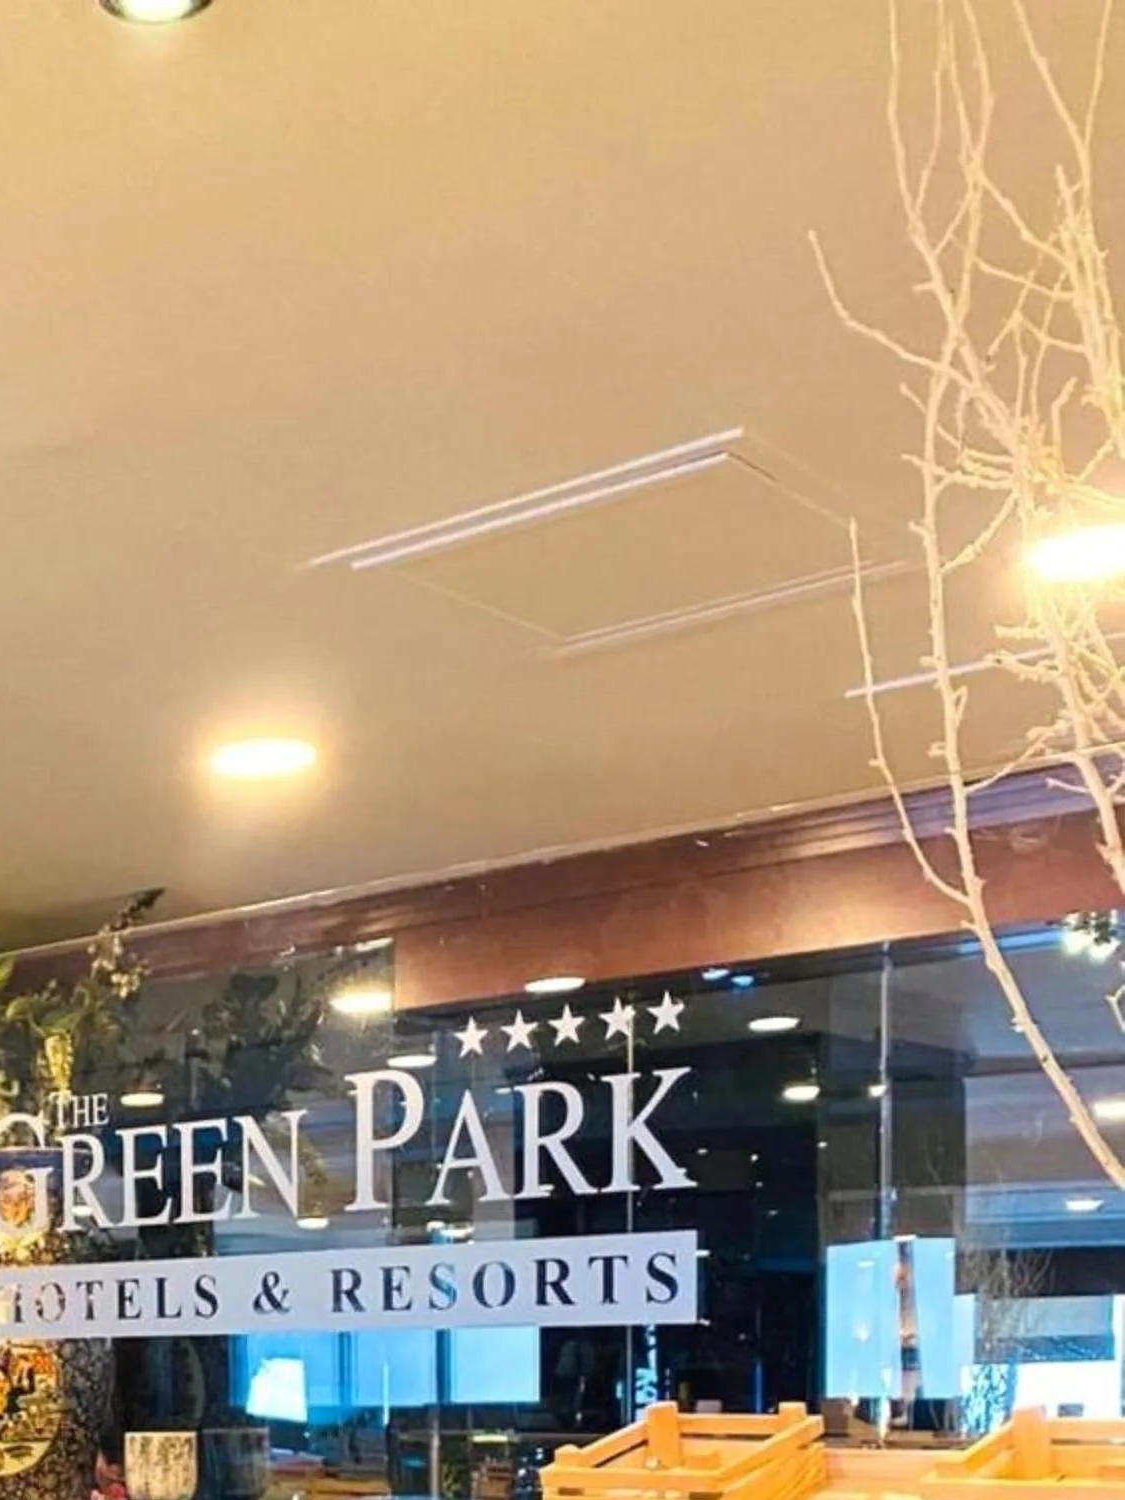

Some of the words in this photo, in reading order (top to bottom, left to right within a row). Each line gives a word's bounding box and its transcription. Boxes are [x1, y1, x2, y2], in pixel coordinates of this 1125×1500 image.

[48, 1091, 110, 1130] THE
[344, 1065, 699, 1213] PARK
[252, 1269, 291, 1316] &
[331, 1251, 681, 1314] RESORTS
